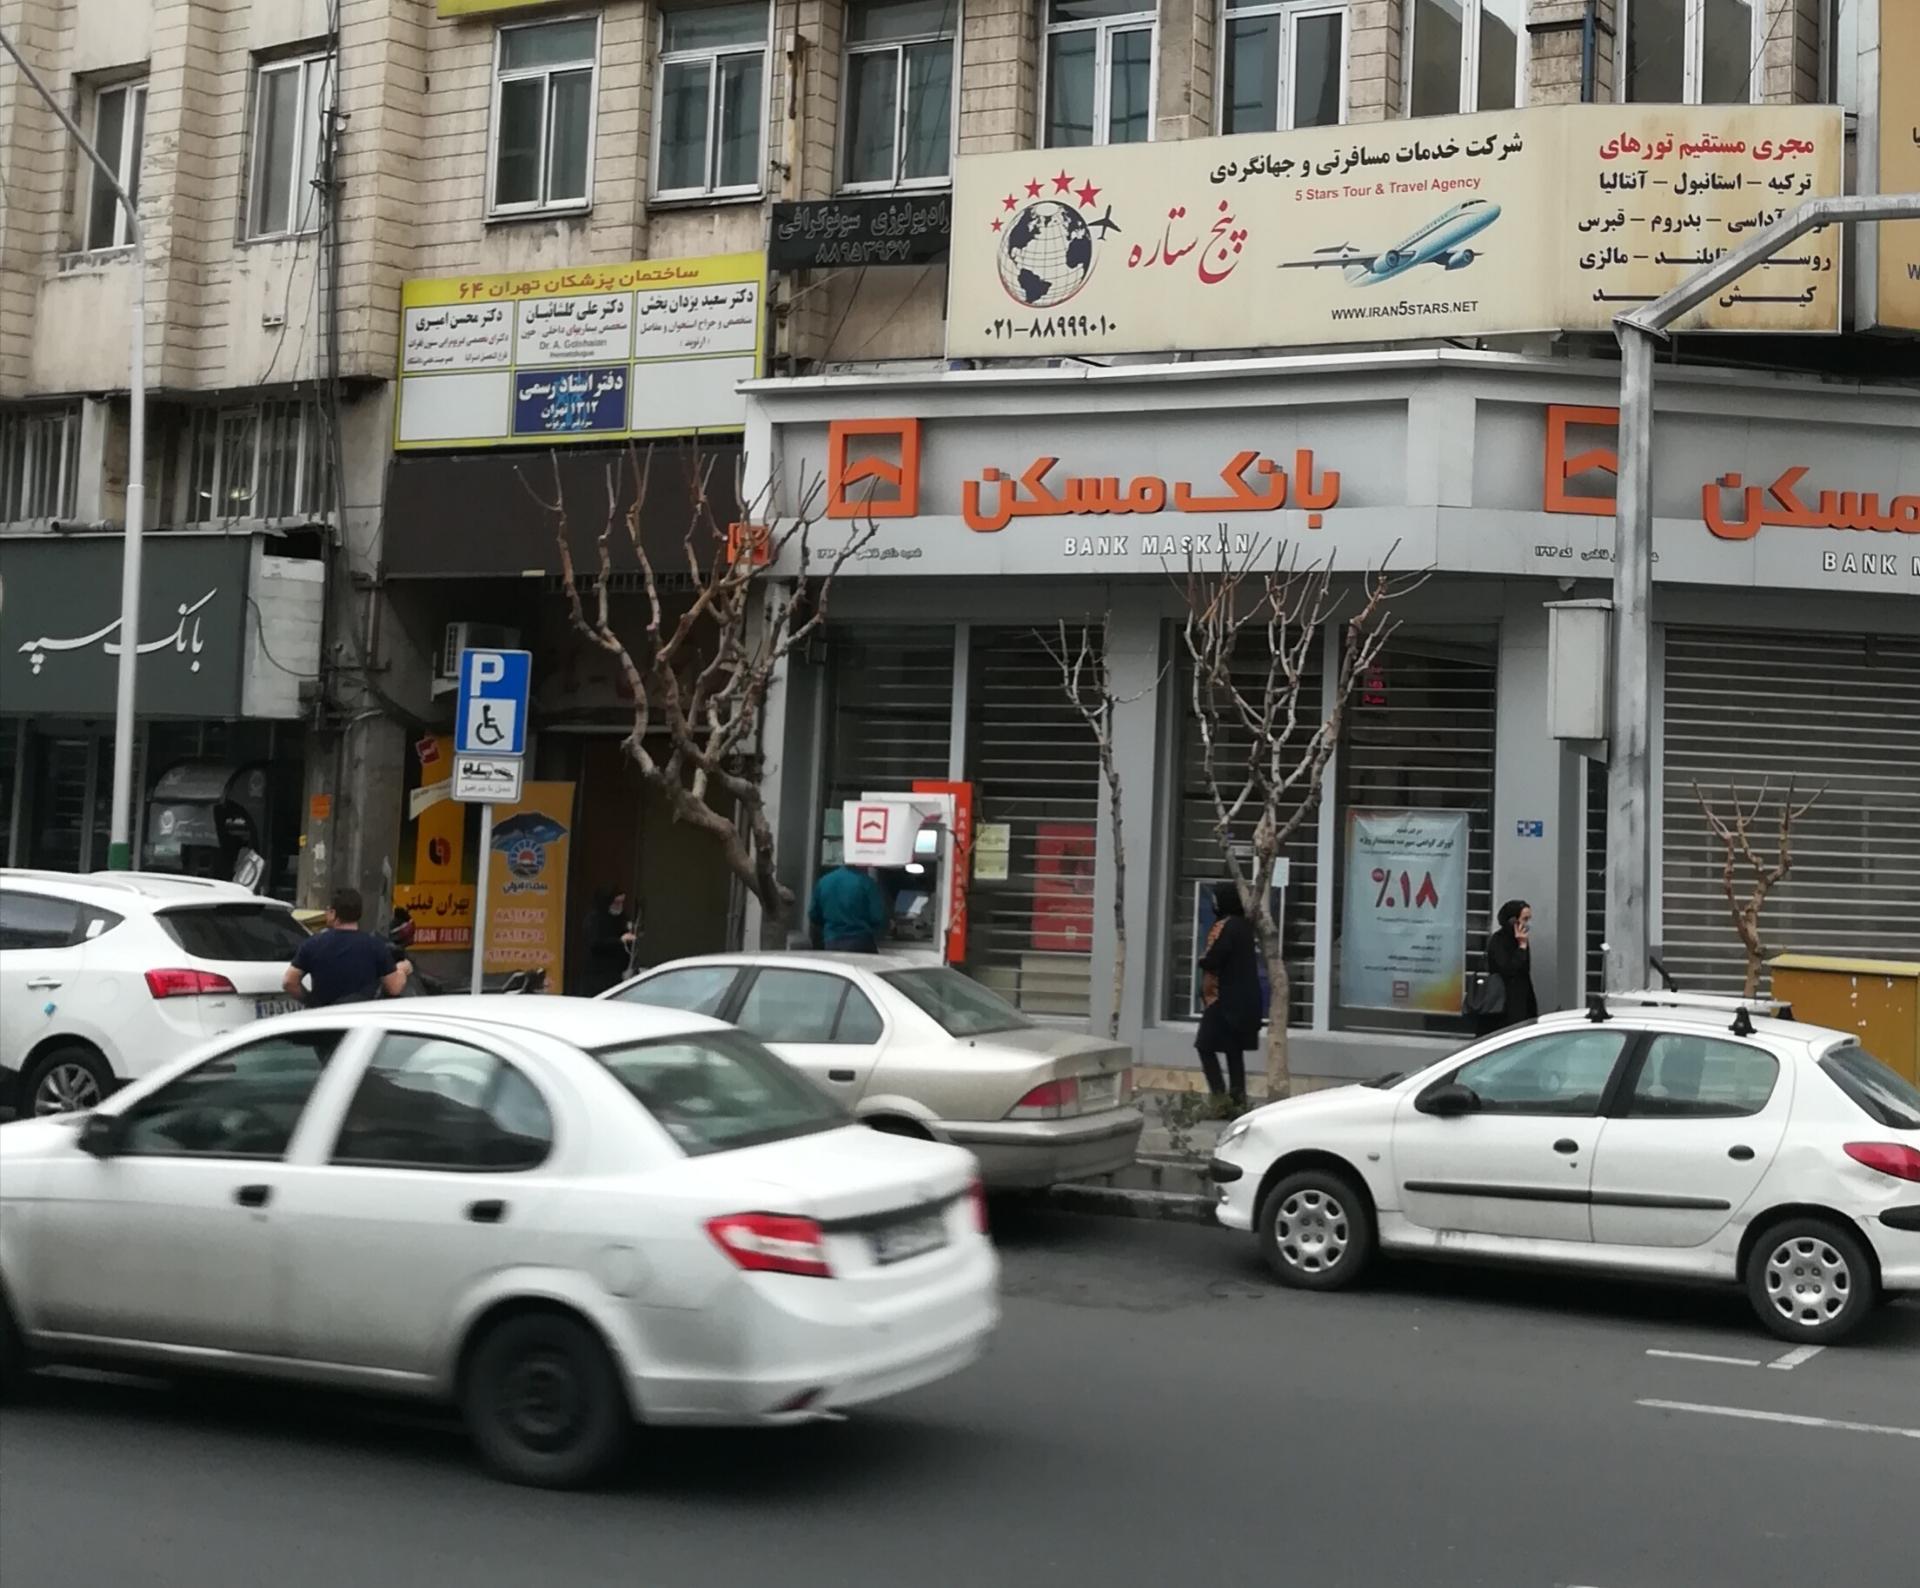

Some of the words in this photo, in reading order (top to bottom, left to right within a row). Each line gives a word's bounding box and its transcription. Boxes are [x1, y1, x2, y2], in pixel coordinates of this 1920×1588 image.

[1395, 136, 1460, 163] خدمات
[1465, 132, 1523, 161] شرکت
[1599, 132, 1674, 161] تورهای
[1678, 134, 1747, 159] مستقیم
[1752, 137, 1815, 160] مجری
[1209, 153, 1296, 184] جهانگردی
[1300, 156, 1311, 178] و
[1315, 145, 1391, 176] مسافرتی
[1295, 188, 1302, 201] 5
[1306, 188, 1339, 200] Stars
[1343, 186, 1371, 198] Tour
[1375, 183, 1384, 195] &
[1389, 179, 1428, 194] Travel
[1431, 177, 1481, 192] Agency
[1599, 170, 1649, 195] آنتالیا
[1673, 172, 1743, 195] استانبول
[1767, 172, 1812, 195] ترکیه
[778, 205, 861, 240] سونوگرافی
[871, 200, 950, 236] رادیولوژی
[1578, 208, 1626, 233] قبرس
[1651, 212, 1701, 233] بدروم
[1128, 206, 1198, 268] ستاره
[1198, 200, 1247, 284] پنج
[1579, 247, 1629, 270] مالزی
[1759, 252, 1832, 271] روسی
[489, 279, 541, 297] تهران
[544, 273, 615, 292] پزشکان
[619, 266, 700, 287] ساختمان
[458, 281, 485, 299] ۶۴
[729, 288, 754, 309] دکتر
[1718, 285, 1817, 307] کیش
[576, 301, 598, 320] علی
[599, 299, 624, 320] دکتر
[640, 296, 668, 315] بخش
[669, 294, 699, 314] یزدان
[701, 294, 728, 310] سعید
[1331, 301, 1479, 320] WWW.IRAN5STARS.NET
[415, 312, 449, 331] امیری
[450, 313, 479, 329] محسن
[480, 308, 503, 328] دکتر
[518, 382, 556, 401] رسمی
[559, 373, 594, 393] اسناد
[593, 370, 624, 398] دفتر
[962, 456, 1167, 533] مسکن
[1175, 449, 1341, 529] بانک
[1064, 536, 1128, 556] BANK
[1141, 534, 1249, 555] MASKAN
[1823, 551, 1897, 576] BANK
[103, 586, 218, 673] بانک
[470, 653, 505, 697] P
